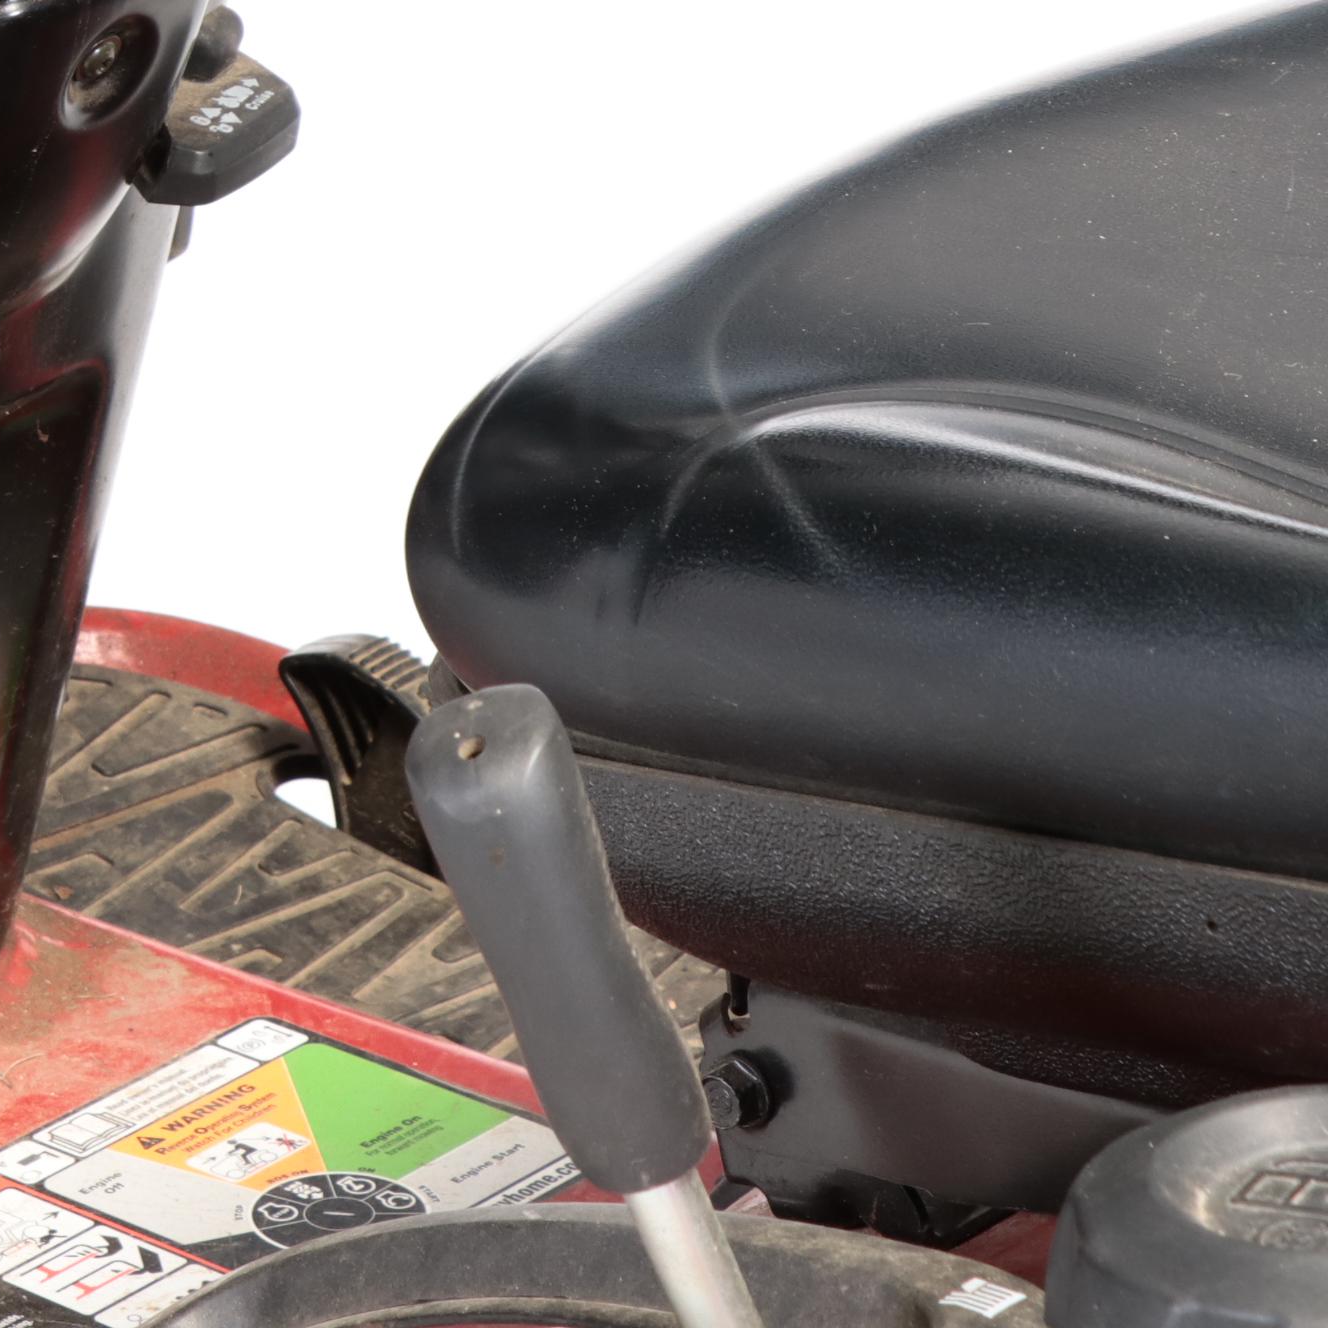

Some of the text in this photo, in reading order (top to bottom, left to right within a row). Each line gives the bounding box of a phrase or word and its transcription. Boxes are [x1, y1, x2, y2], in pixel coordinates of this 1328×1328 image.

[155, 1133, 195, 1155] Reverse
[239, 1092, 277, 1112] System
[162, 1084, 256, 1132] WARNING
[182, 1135, 216, 1153] Watch
[360, 1115, 422, 1148] Engine On
[451, 1143, 526, 1184] Engine Start
[78, 1171, 125, 1195] Engine Off
